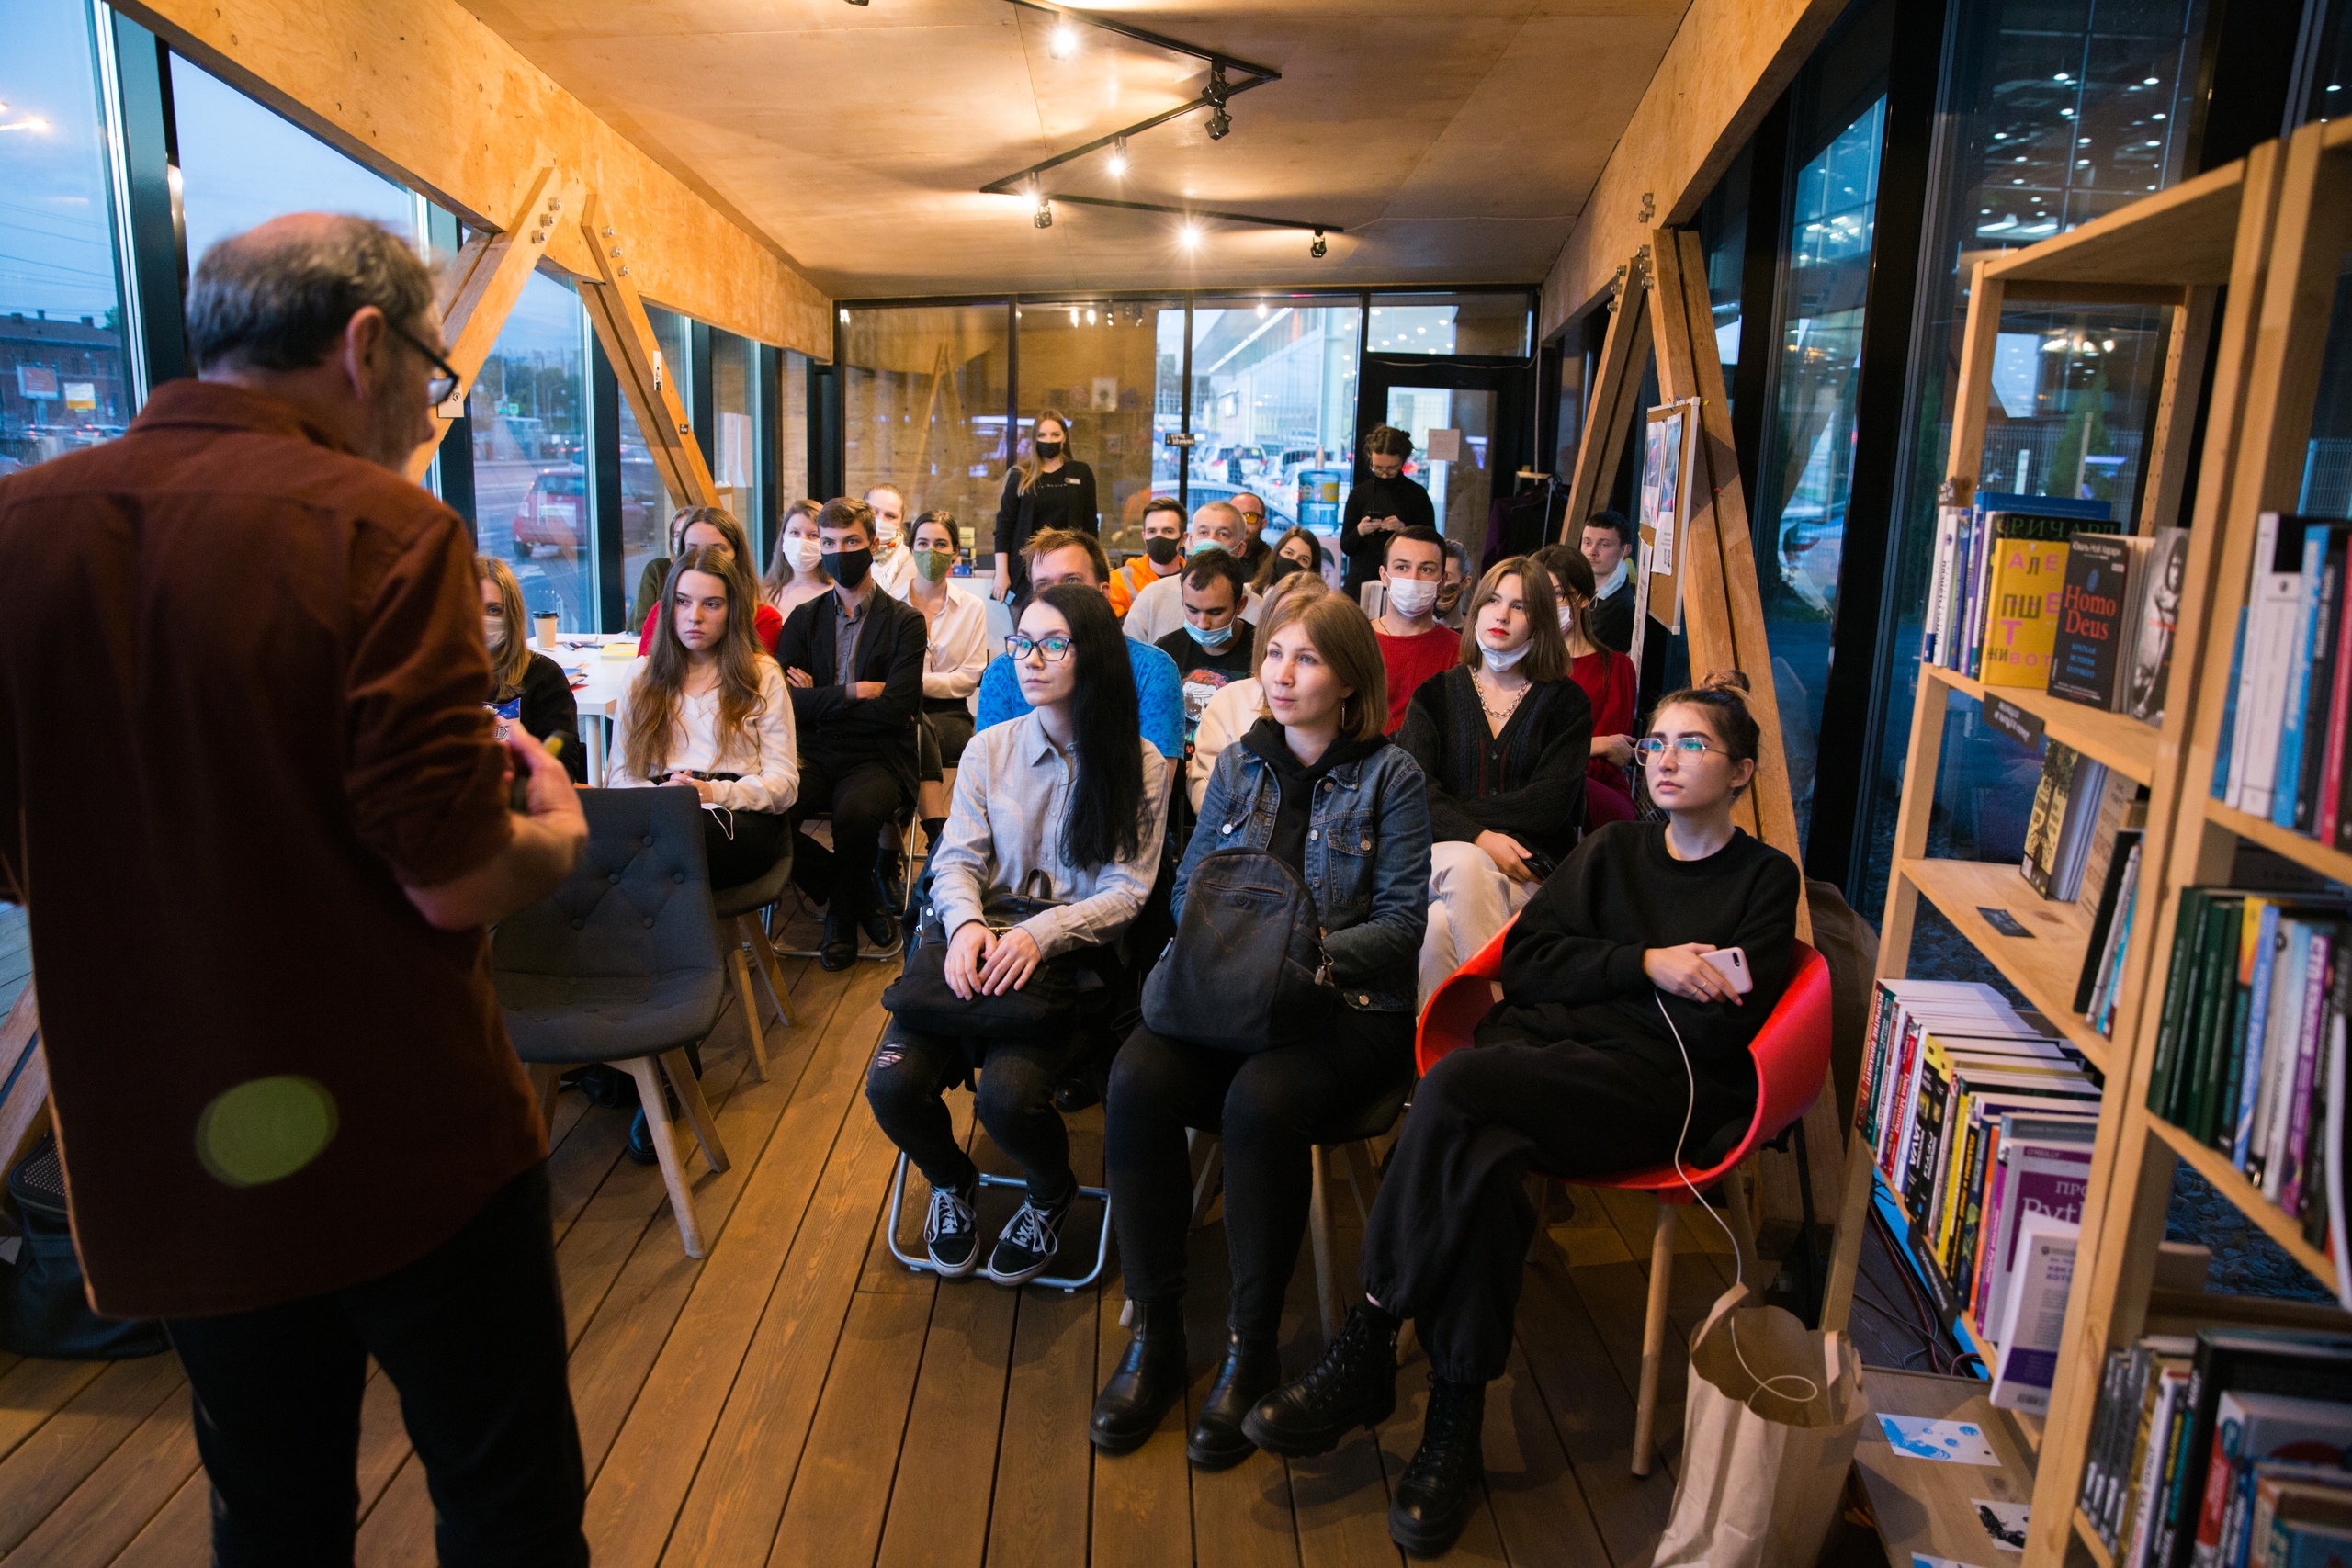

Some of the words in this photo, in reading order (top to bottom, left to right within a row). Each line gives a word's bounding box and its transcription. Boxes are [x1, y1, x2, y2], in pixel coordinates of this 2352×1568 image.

[2064, 584, 2117, 617] Homo
[2064, 609, 2109, 640] Deus
[1871, 991, 1884, 1039] ВСКРЫТИЕ
[1863, 1039, 1877, 1086] ПОКАЖЕТ!
[1901, 1071, 1910, 1098] Data
[1894, 1096, 1905, 1134] Mining
[1910, 1120, 1921, 1166] JAVA
[2055, 1181, 2088, 1197] ПРО
[1984, 1248, 1994, 1283] Python
